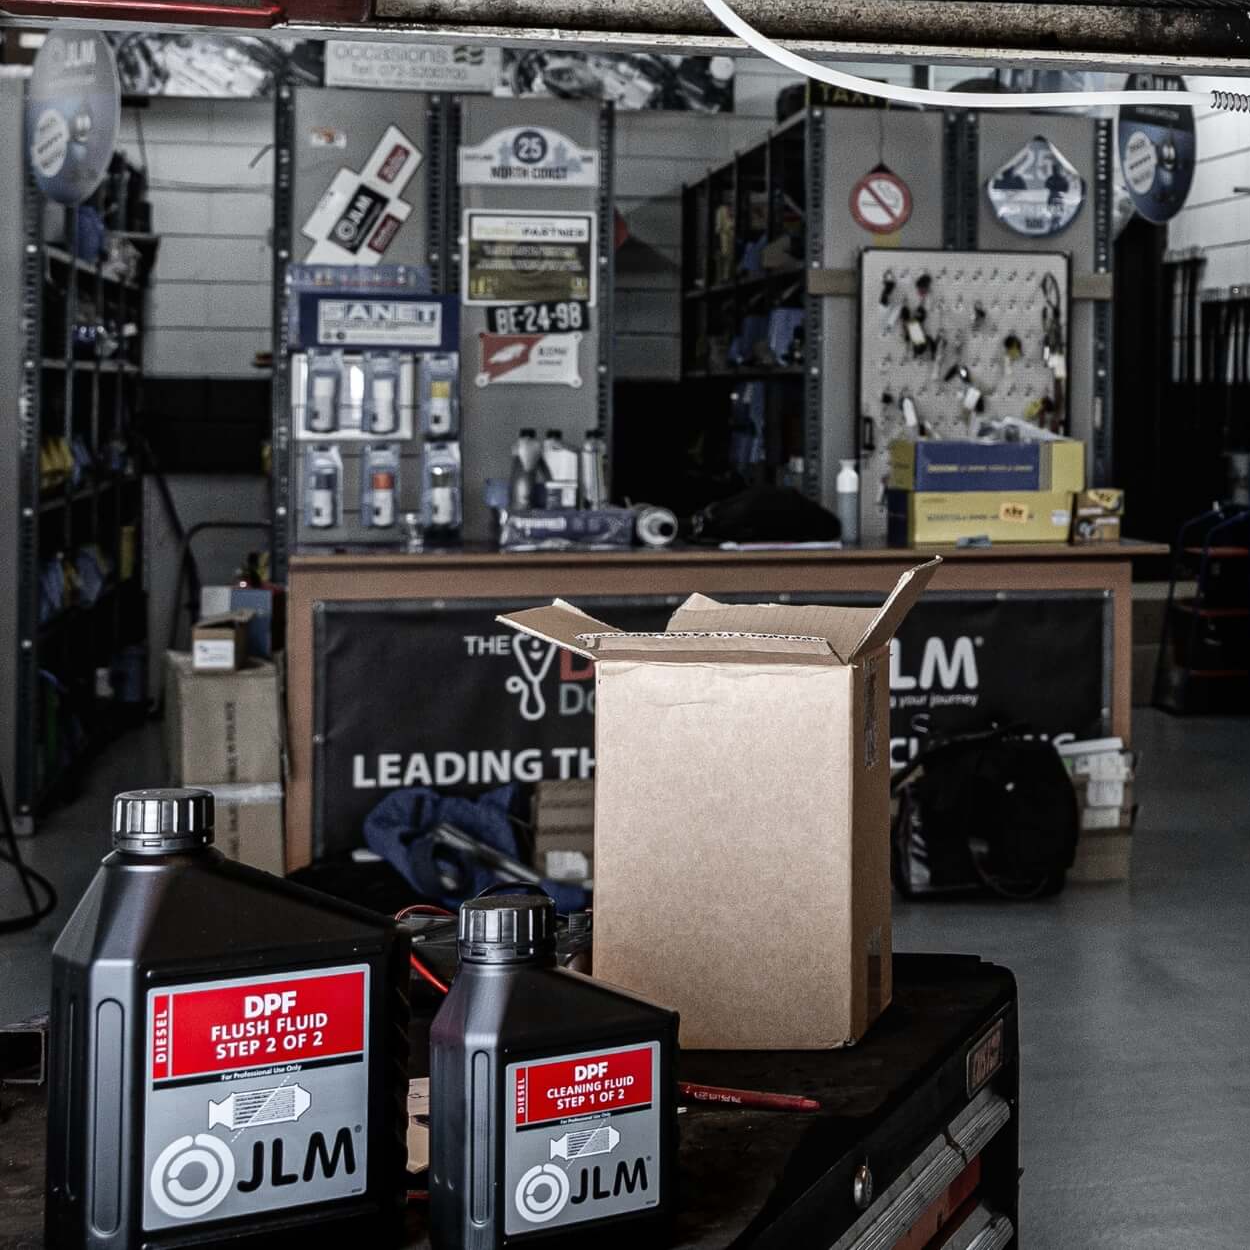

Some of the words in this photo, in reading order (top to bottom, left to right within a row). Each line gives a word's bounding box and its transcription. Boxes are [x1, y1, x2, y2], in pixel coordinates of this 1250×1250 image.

[518, 136, 543, 160] 25
[464, 635, 511, 656] THE
[889, 636, 979, 689] LM
[353, 749, 543, 788] LEADING
[551, 747, 596, 780] TH
[244, 991, 297, 1018] DPF
[155, 1010, 168, 1064] DIESEL
[211, 1022, 270, 1042] FLUSH
[276, 1013, 328, 1029] FLUID
[216, 1040, 260, 1059] STEP
[266, 1038, 277, 1054] 2
[283, 1035, 307, 1050] OF
[313, 1031, 323, 1046] 2
[221, 1072, 232, 1081] For
[233, 1068, 273, 1080] Professional
[273, 1065, 285, 1075] Use
[286, 1063, 302, 1074] Only
[574, 1062, 608, 1082] DPF
[517, 1077, 525, 1114] DIESEL
[546, 1081, 602, 1099] CLEANING
[604, 1075, 634, 1090] FLUID
[556, 1095, 585, 1110] STEP
[589, 1094, 595, 1104] 1
[600, 1091, 614, 1102] OF
[618, 1088, 625, 1099] 2
[237, 1127, 355, 1193] JLM
[570, 1157, 648, 1204] JLM
